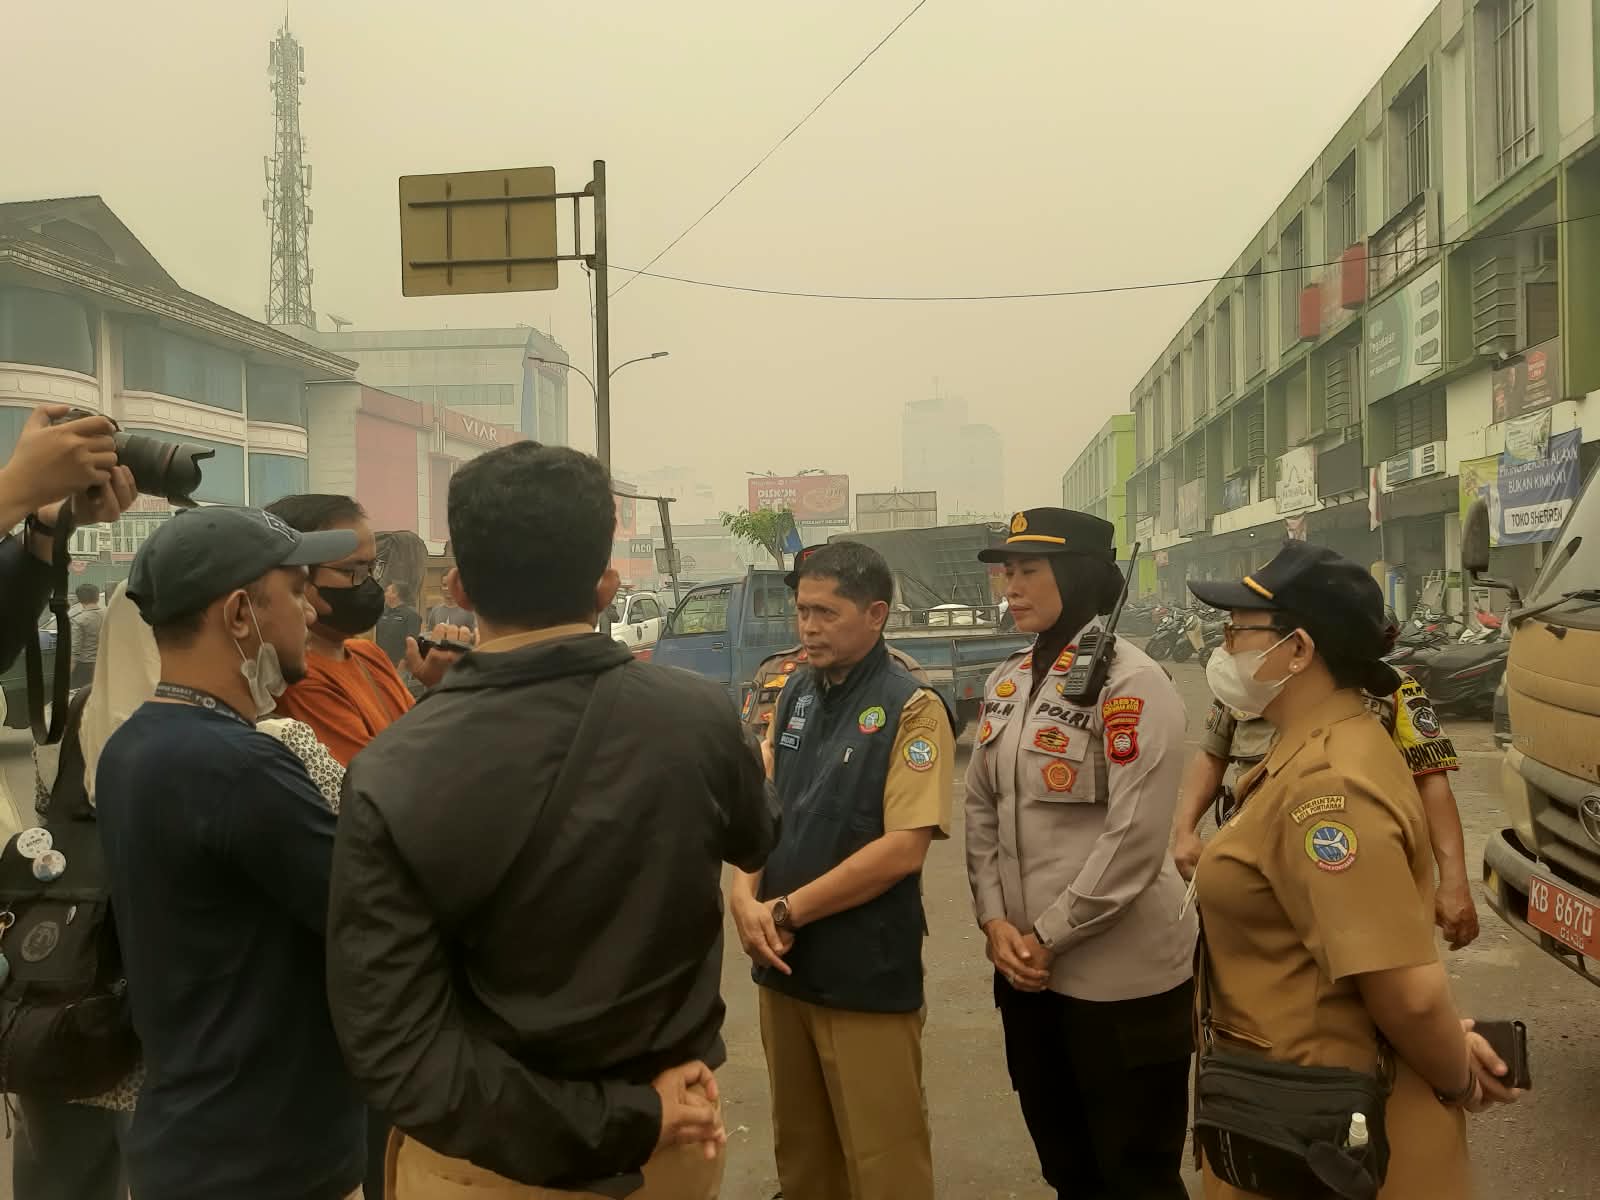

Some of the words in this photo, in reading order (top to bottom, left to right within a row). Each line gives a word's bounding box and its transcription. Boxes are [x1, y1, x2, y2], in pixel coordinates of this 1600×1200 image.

[461, 416, 497, 442] VIAR
[1508, 478, 1533, 494] BUKAN
[1511, 511, 1529, 527] TOKO
[1530, 507, 1563, 525] SHERREN
[1036, 702, 1090, 729] POLRI
[1531, 879, 1549, 913] KB
